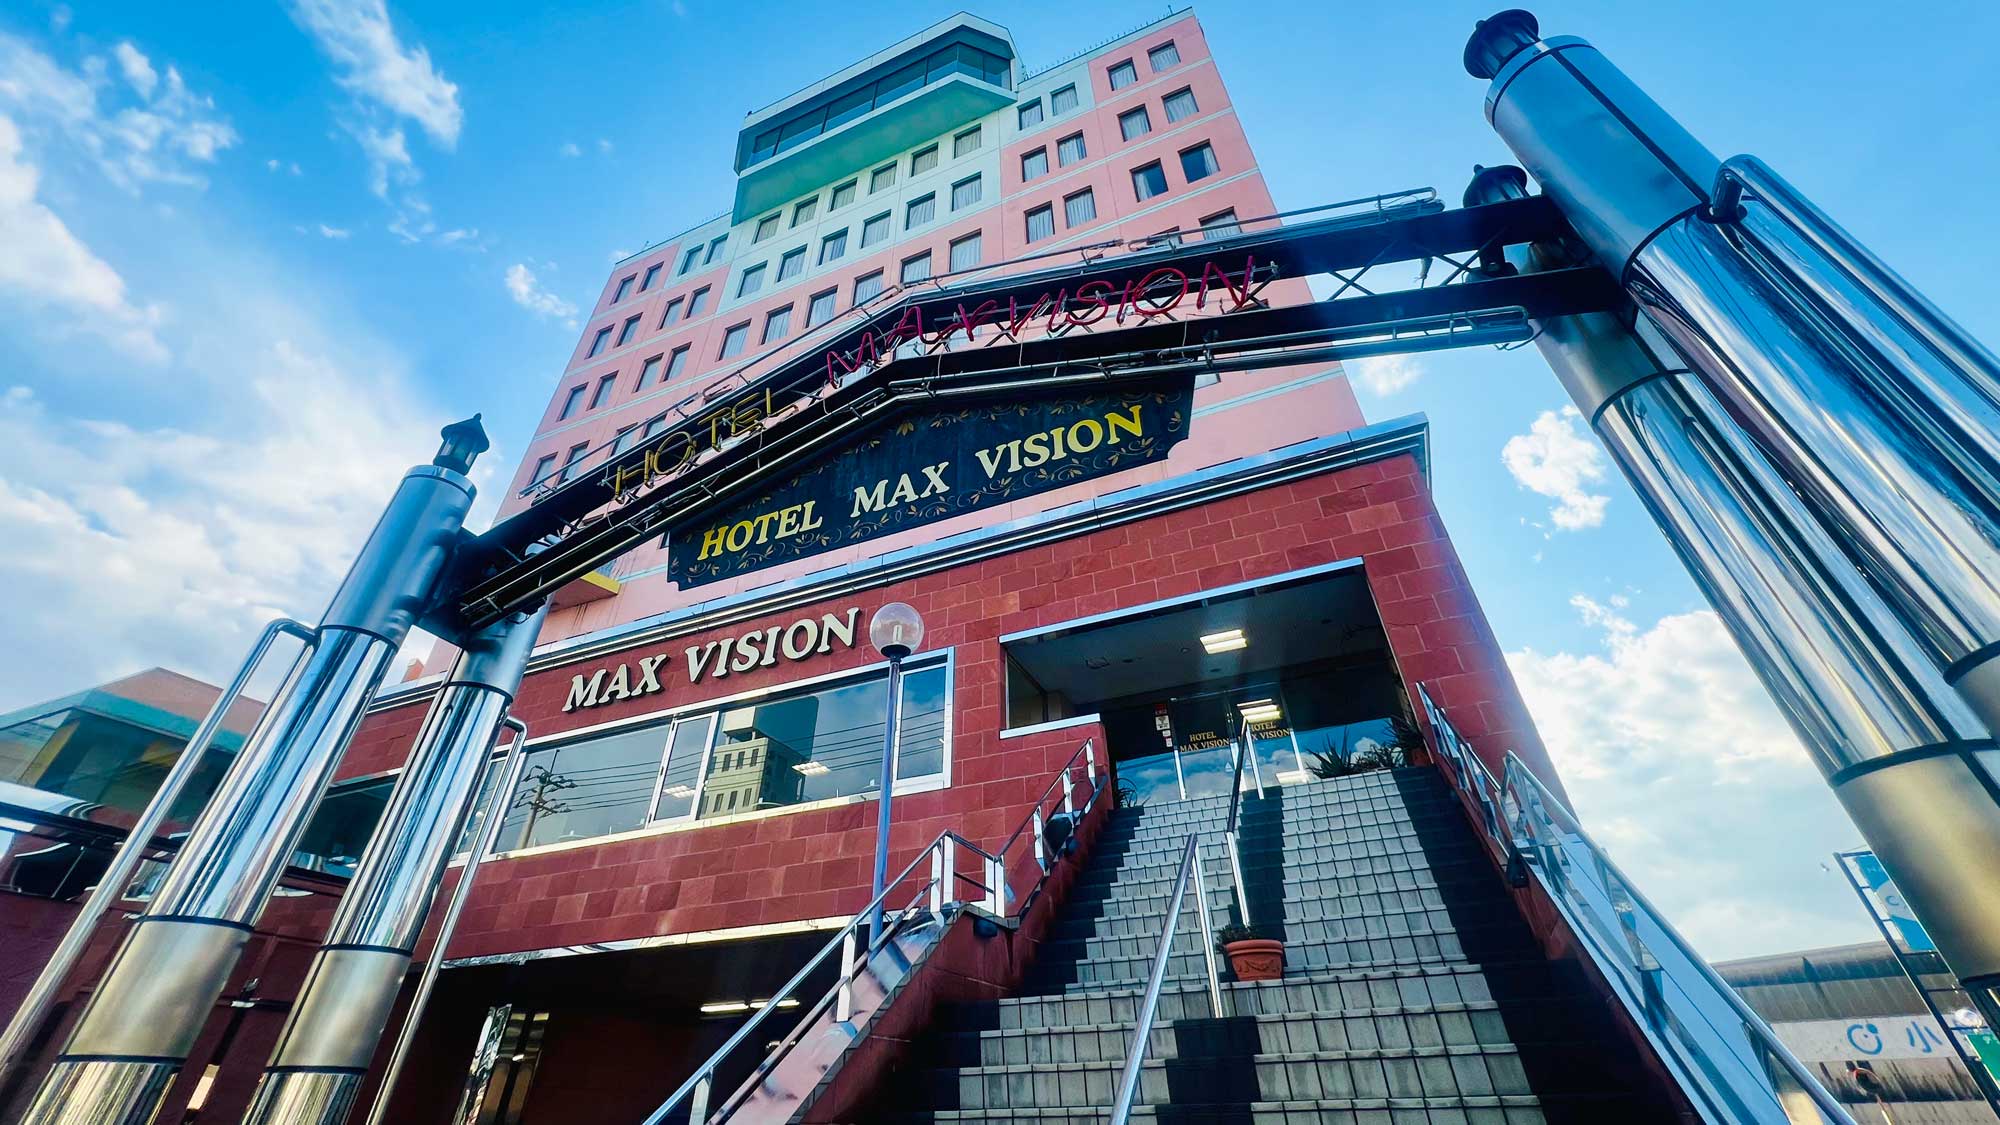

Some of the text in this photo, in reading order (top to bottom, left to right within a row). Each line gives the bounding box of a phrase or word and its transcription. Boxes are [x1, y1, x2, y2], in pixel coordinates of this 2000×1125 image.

[613, 387, 800, 504] HOTEL
[696, 404, 1143, 561] HOTEL MAX VISION
[562, 607, 861, 713] MAX VISION
[1180, 738, 1231, 753] MAX VISION
[1189, 731, 1217, 742] HOTEL
[1260, 728, 1291, 740] VISION
